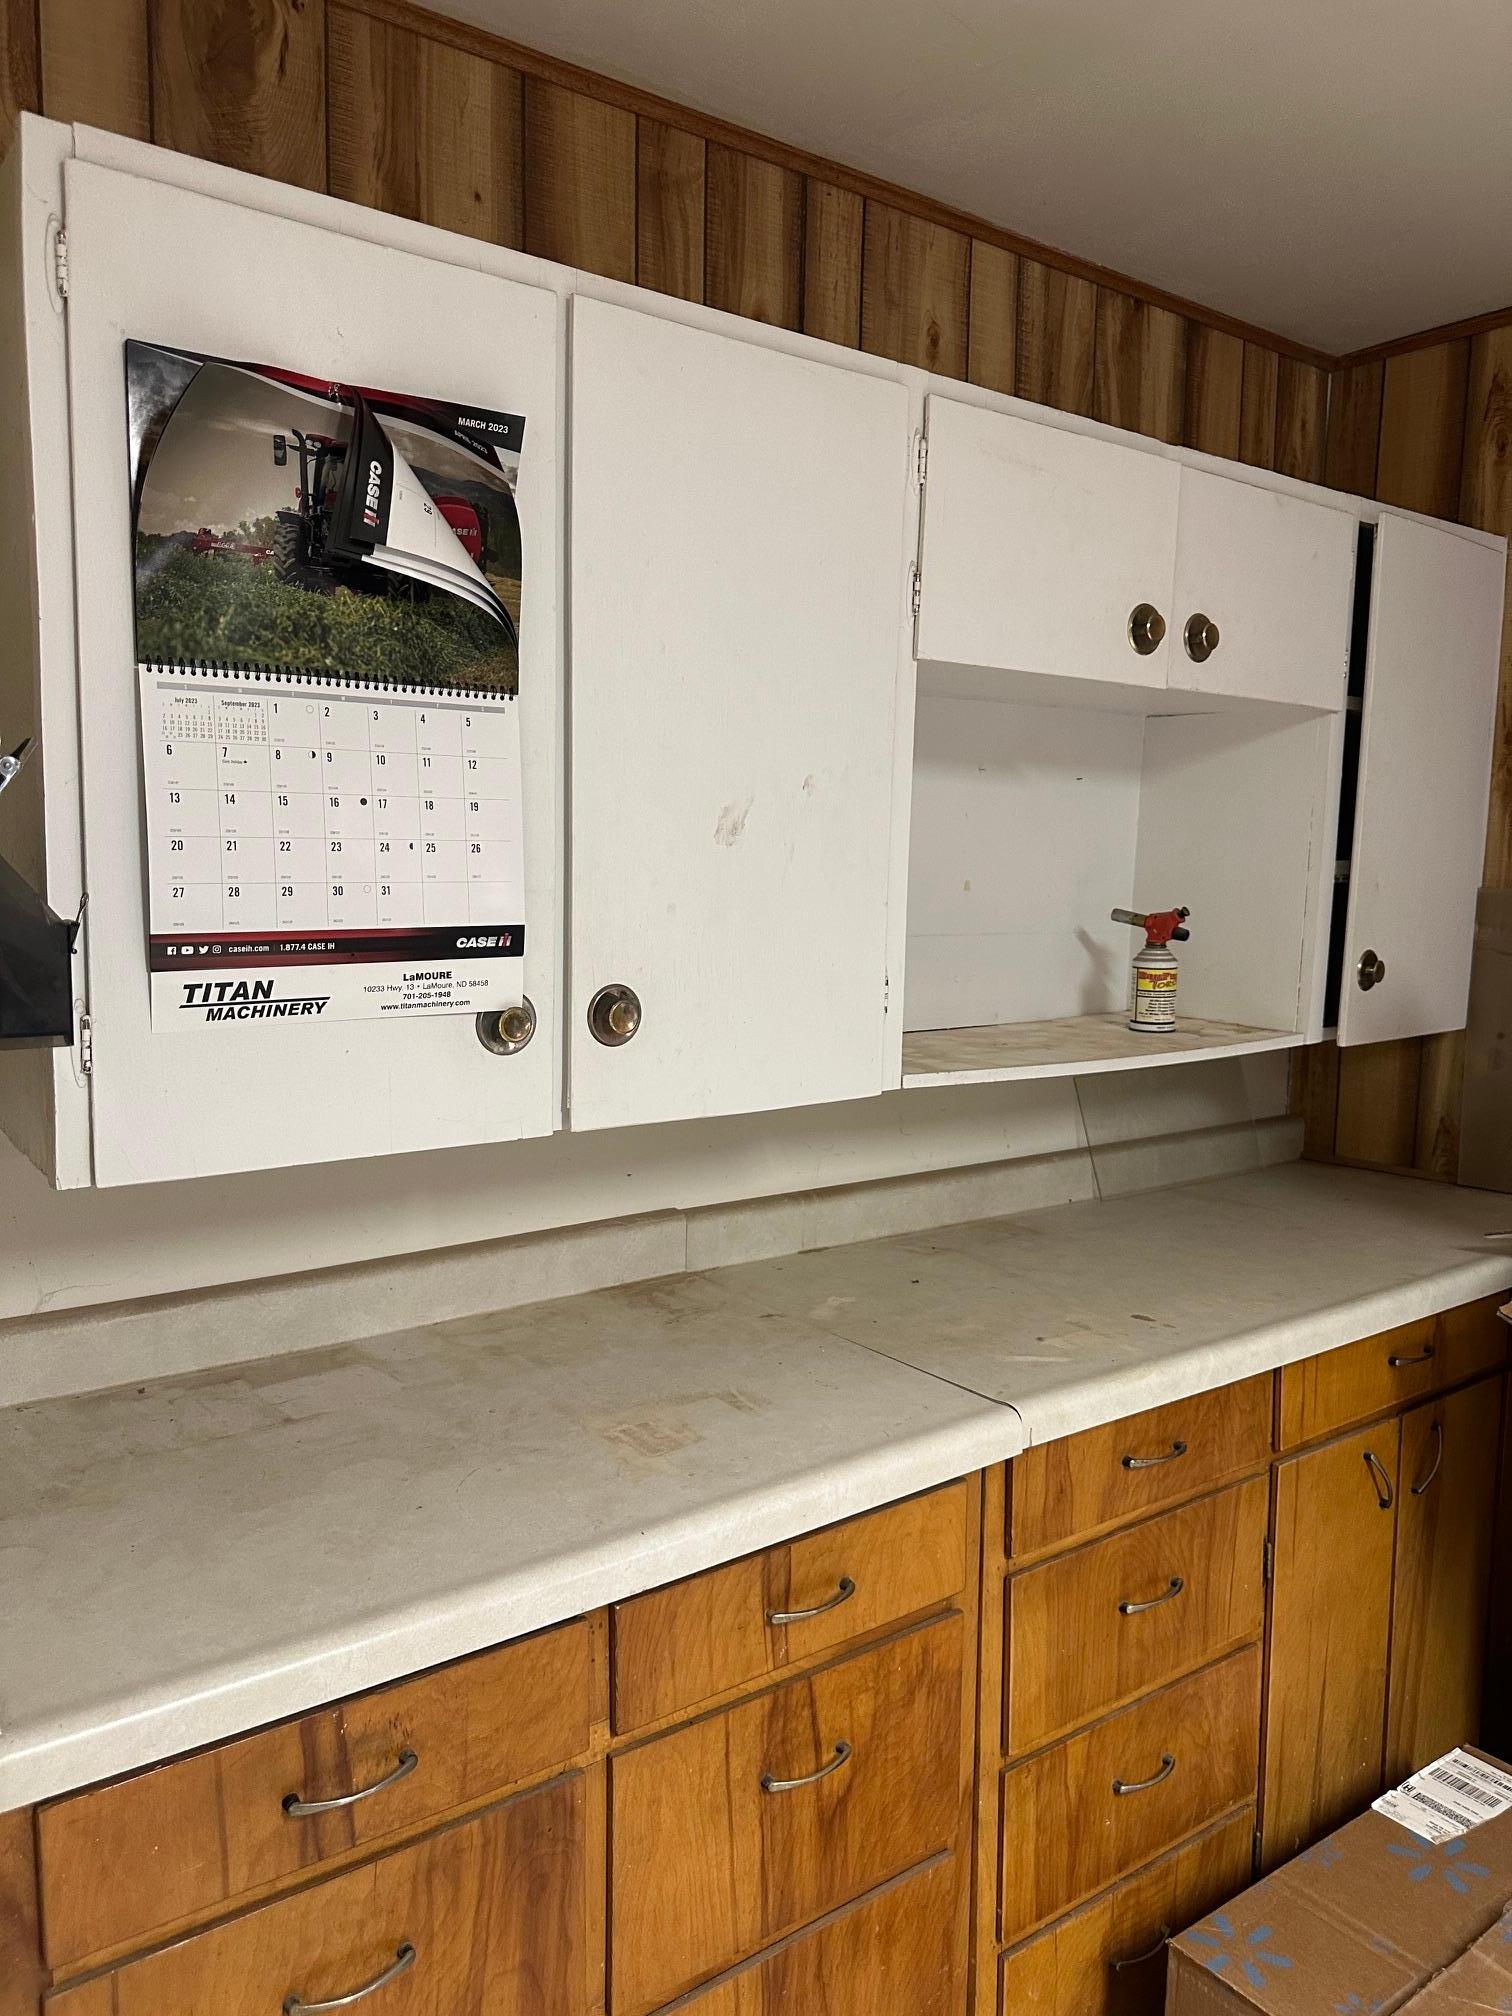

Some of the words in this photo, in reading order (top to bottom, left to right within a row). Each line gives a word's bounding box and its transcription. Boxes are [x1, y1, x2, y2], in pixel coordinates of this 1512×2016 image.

[458, 417, 487, 430] MARCH
[488, 423, 509, 434] 2023
[365, 460, 382, 510] CASE
[221, 700, 248, 708] September
[274, 703, 277, 713] 1
[325, 707, 329, 717] 2
[374, 711, 378, 720] 3
[421, 714, 425, 723] 4
[466, 718, 470, 727] 5
[167, 745, 172, 755] 6
[222, 747, 227, 757] 7
[276, 750, 280, 759] 8
[327, 752, 332, 762] 9
[376, 755, 385, 765] 10
[423, 758, 430, 767] 11
[468, 760, 477, 769] 12
[170, 793, 180, 803] 13
[225, 794, 235, 804] 14
[278, 796, 288, 806] 15
[330, 798, 339, 807] 16
[378, 799, 387, 808] 17
[425, 801, 433, 810] 18
[470, 802, 478, 811] 19
[171, 840, 183, 850] 20
[227, 841, 236, 851] 21
[280, 841, 290, 851] 22
[331, 842, 341, 851] 23
[380, 843, 389, 852] 24
[426, 843, 435, 852] 25
[471, 844, 480, 853] 26
[173, 888, 184, 897] 27
[229, 887, 239, 897] 28
[282, 886, 292, 896] 29
[333, 886, 343, 895] 30
[382, 886, 390, 895] 31
[228, 945, 270, 953] caseih.com
[280, 943, 306, 951] 1.877.4
[307, 942, 326, 951] CASE
[327, 942, 335, 950] IH
[456, 936, 498, 948] CASE
[403, 971, 453, 982] LaMOURE
[183, 979, 274, 1004] TITAN
[363, 985, 385, 993] 10233
[406, 983, 415, 991] 13
[456, 980, 468, 988] ND
[468, 979, 489, 987] 58458
[402, 990, 452, 1000] 701-205-1948
[206, 1001, 328, 1022] MACHINERY
[380, 999, 471, 1011] www.titanmachinery.com
